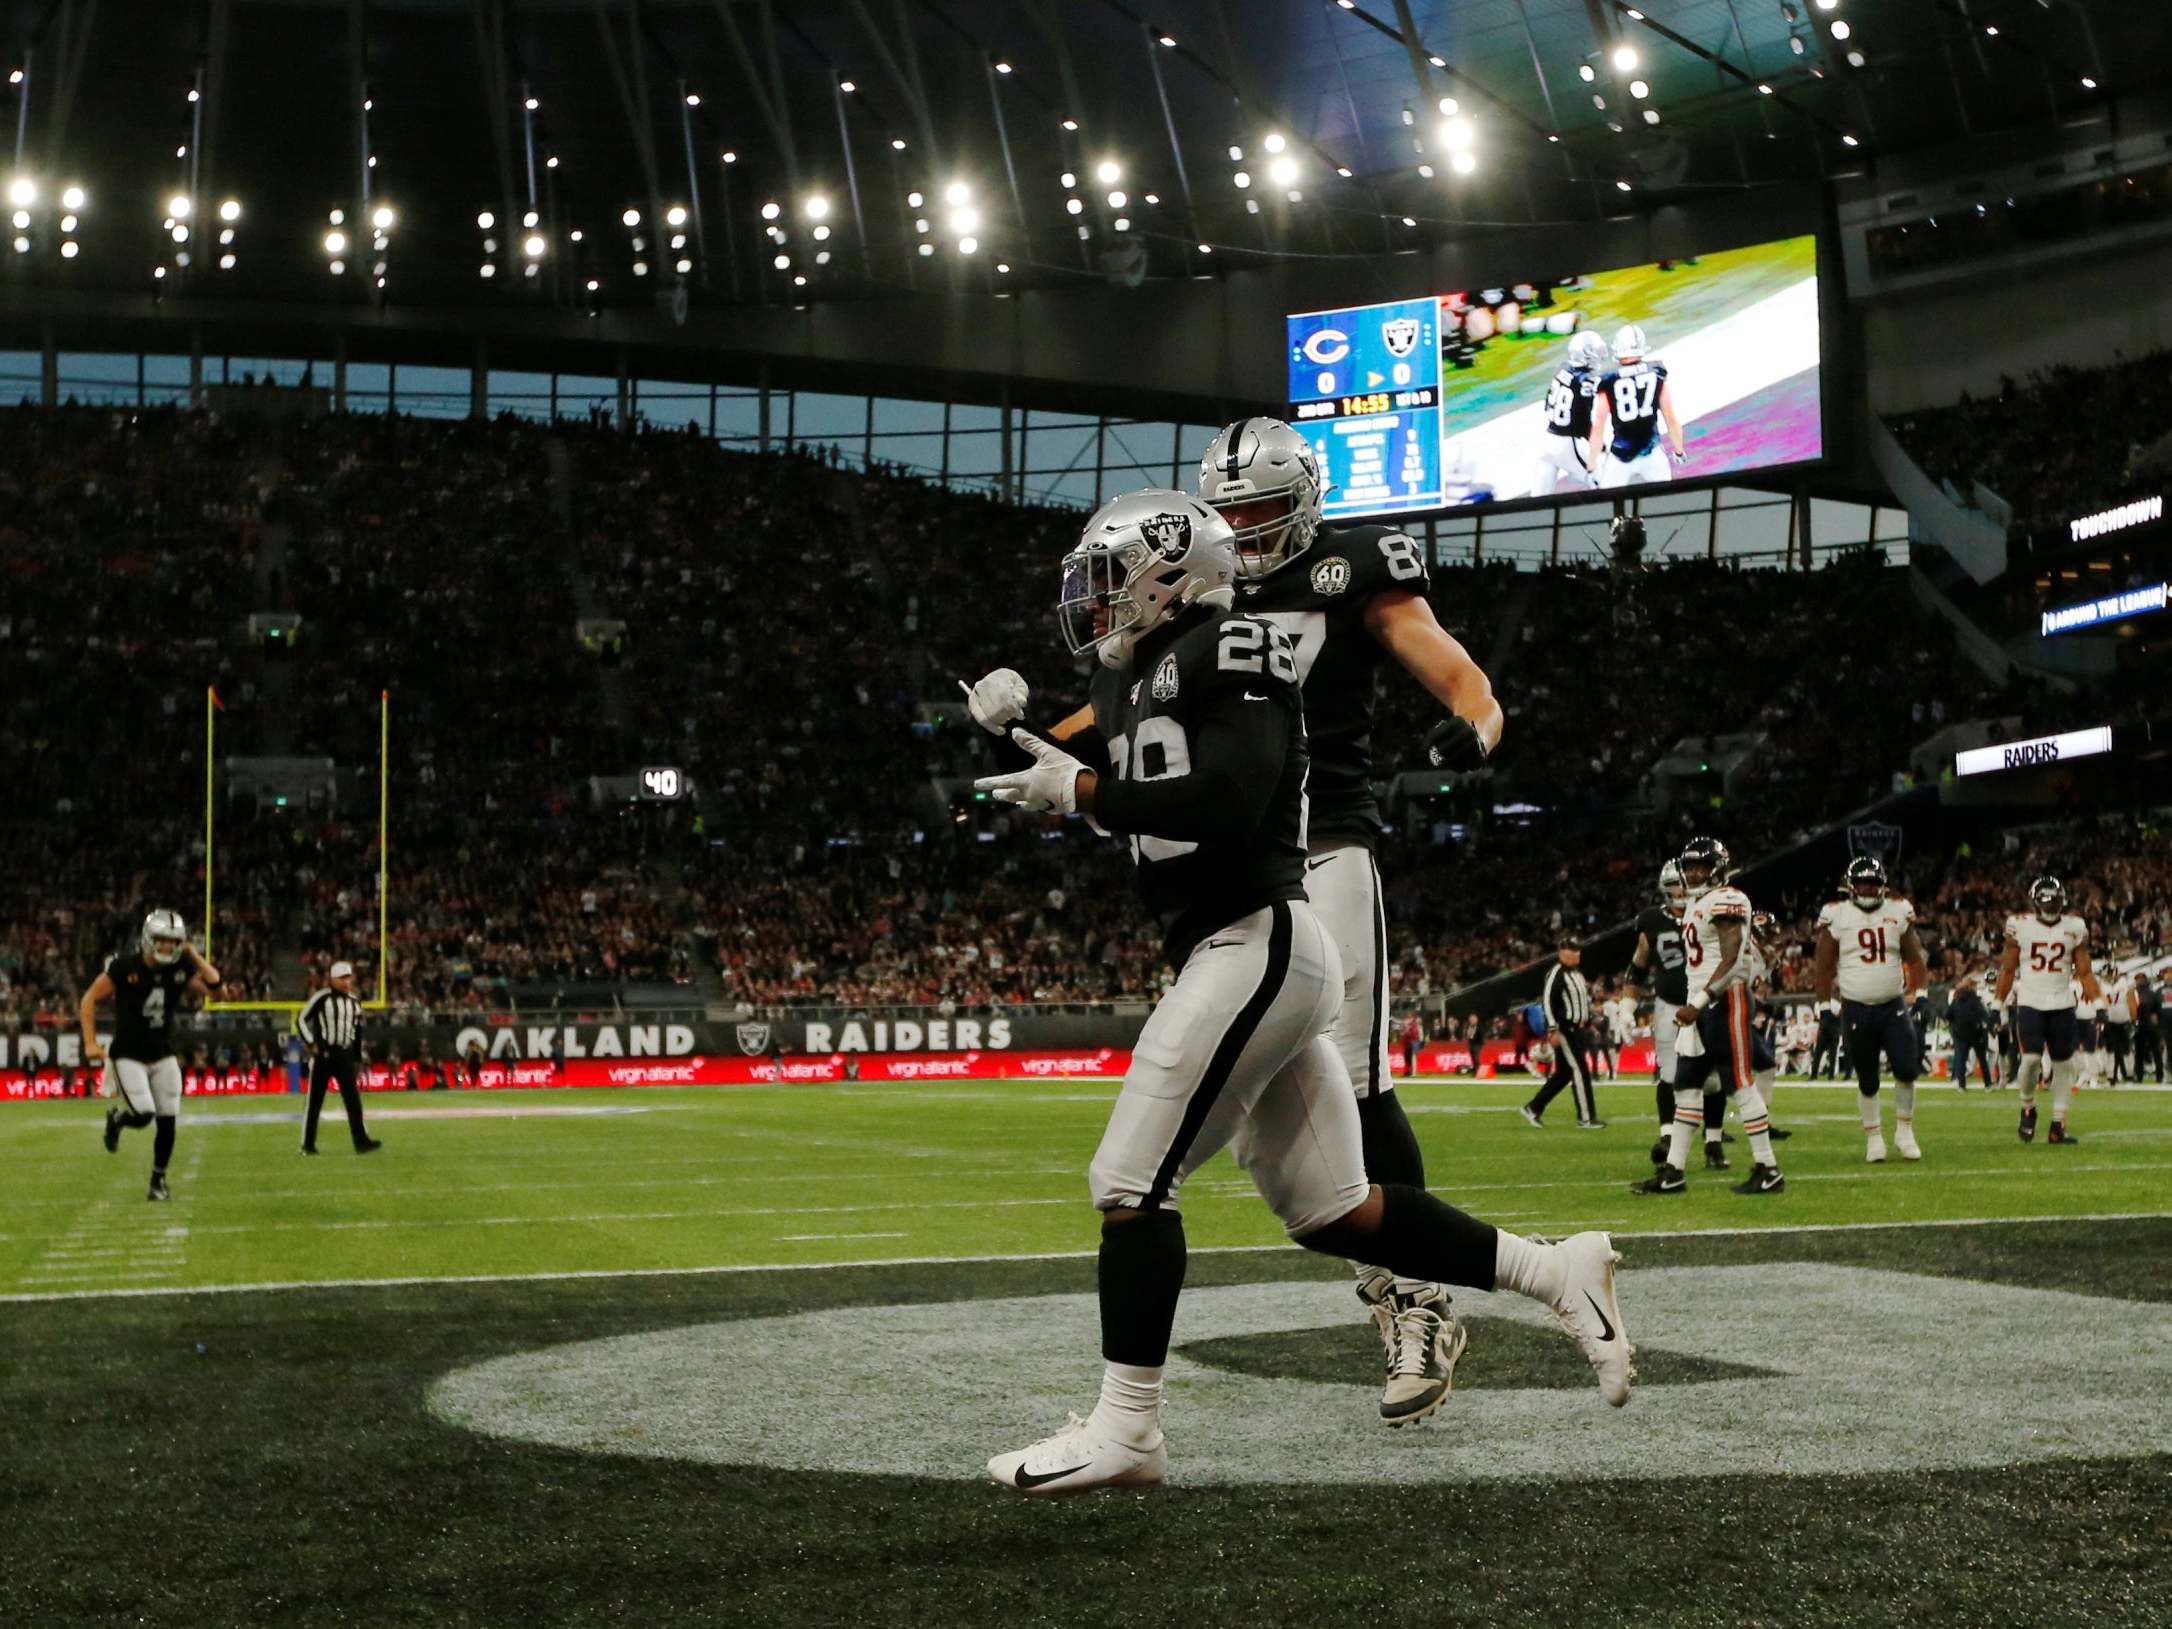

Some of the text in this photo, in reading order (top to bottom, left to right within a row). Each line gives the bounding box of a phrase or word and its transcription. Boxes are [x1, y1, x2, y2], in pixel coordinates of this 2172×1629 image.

[1317, 372, 1336, 394] 0
[1393, 363, 1411, 385] 0
[1342, 393, 1389, 416] 14:55
[1614, 372, 1658, 422] 87
[2070, 495, 2162, 542] TOUCHDOWN
[1378, 534, 1430, 581] 8
[1316, 564, 1345, 582] 60
[2098, 598, 2119, 618] THE
[1218, 620, 1298, 684] 28
[2004, 739, 2059, 768] RAIDERS
[645, 770, 677, 796] 40
[1858, 927, 1886, 963] 91
[2031, 942, 2066, 972] 52
[142, 988, 165, 1029] 4
[456, 1020, 1012, 1059] OAKLAND RAIDERS
